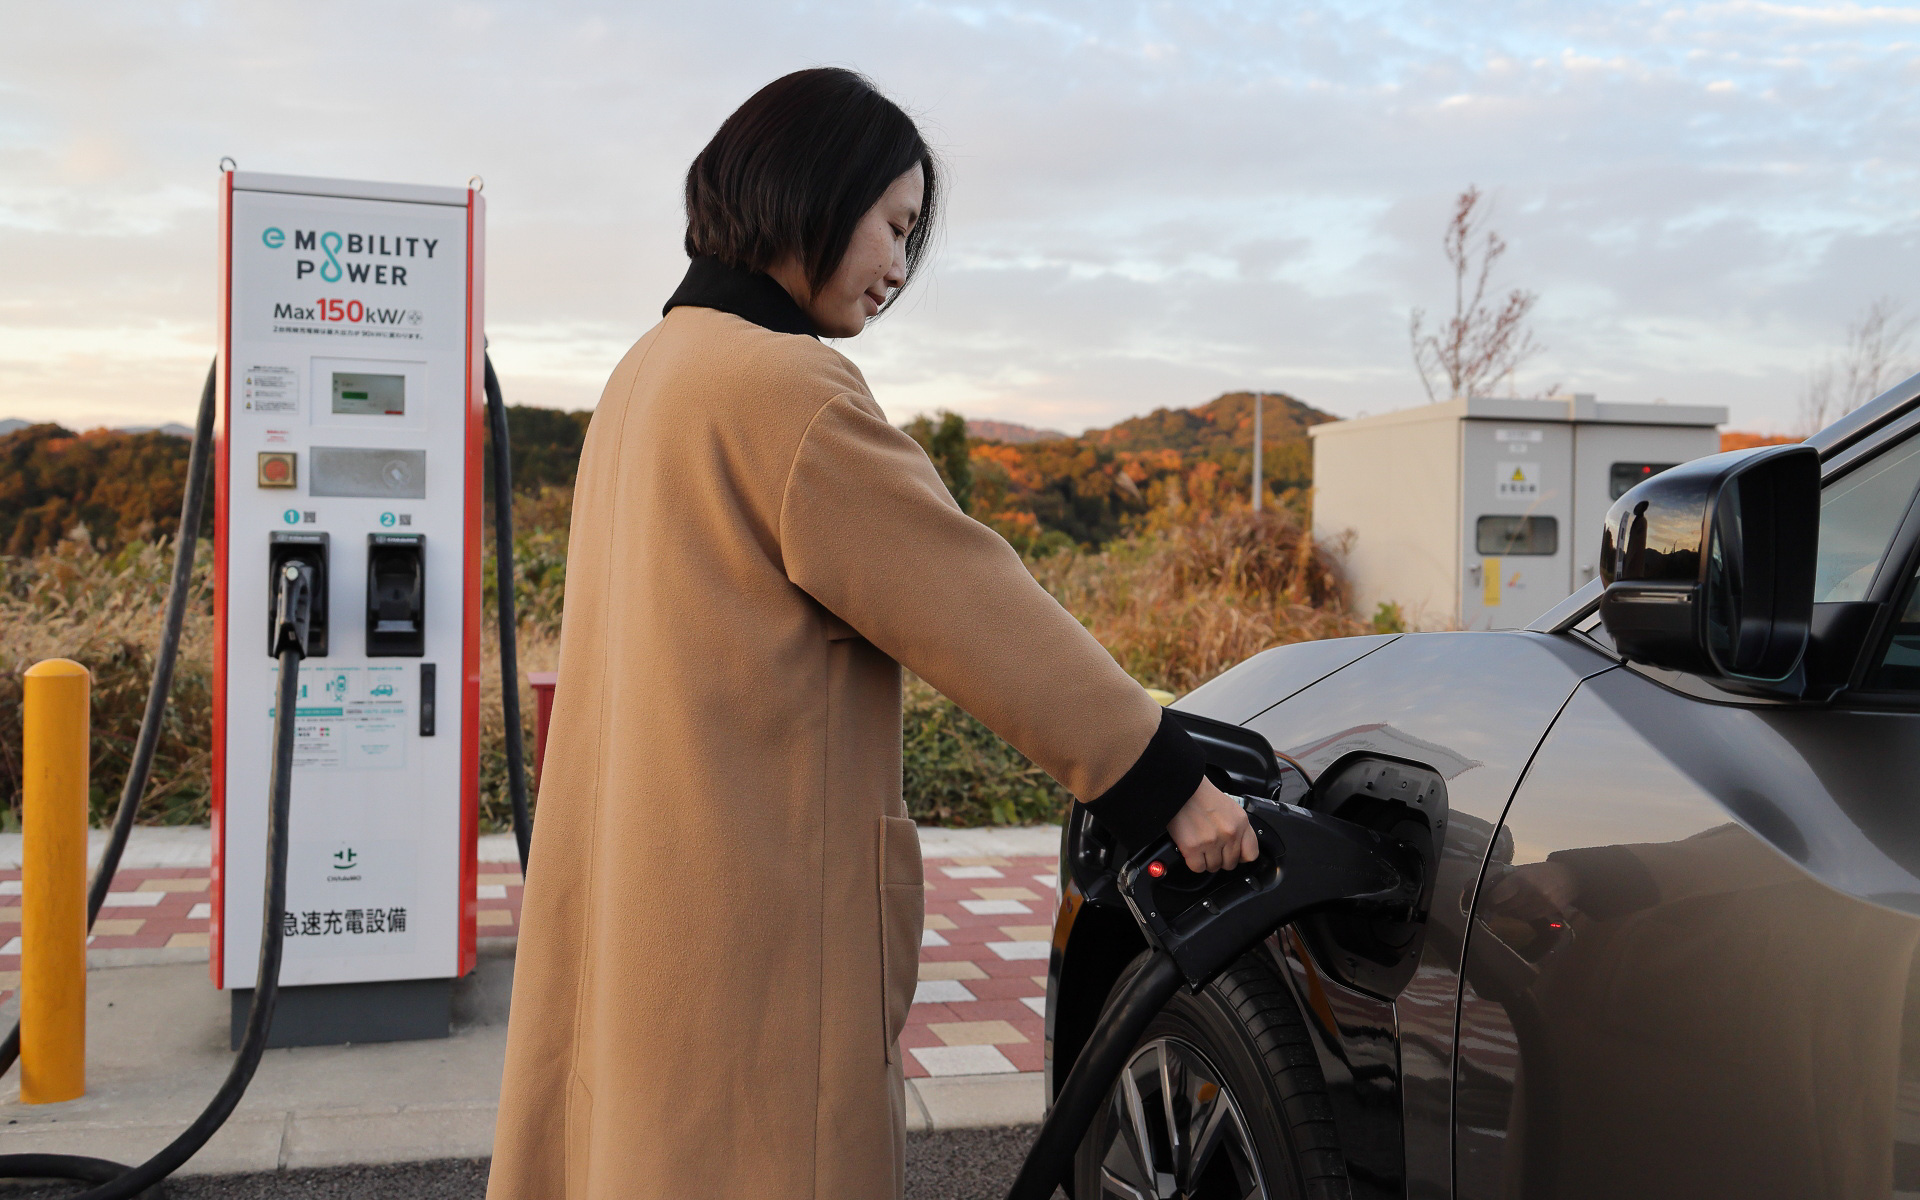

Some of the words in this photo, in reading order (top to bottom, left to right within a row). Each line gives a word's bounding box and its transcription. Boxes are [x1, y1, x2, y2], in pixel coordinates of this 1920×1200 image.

[295, 229, 439, 259] MOBILITY
[297, 259, 408, 286] POWER
[284, 907, 407, 937] 急速充電設備
